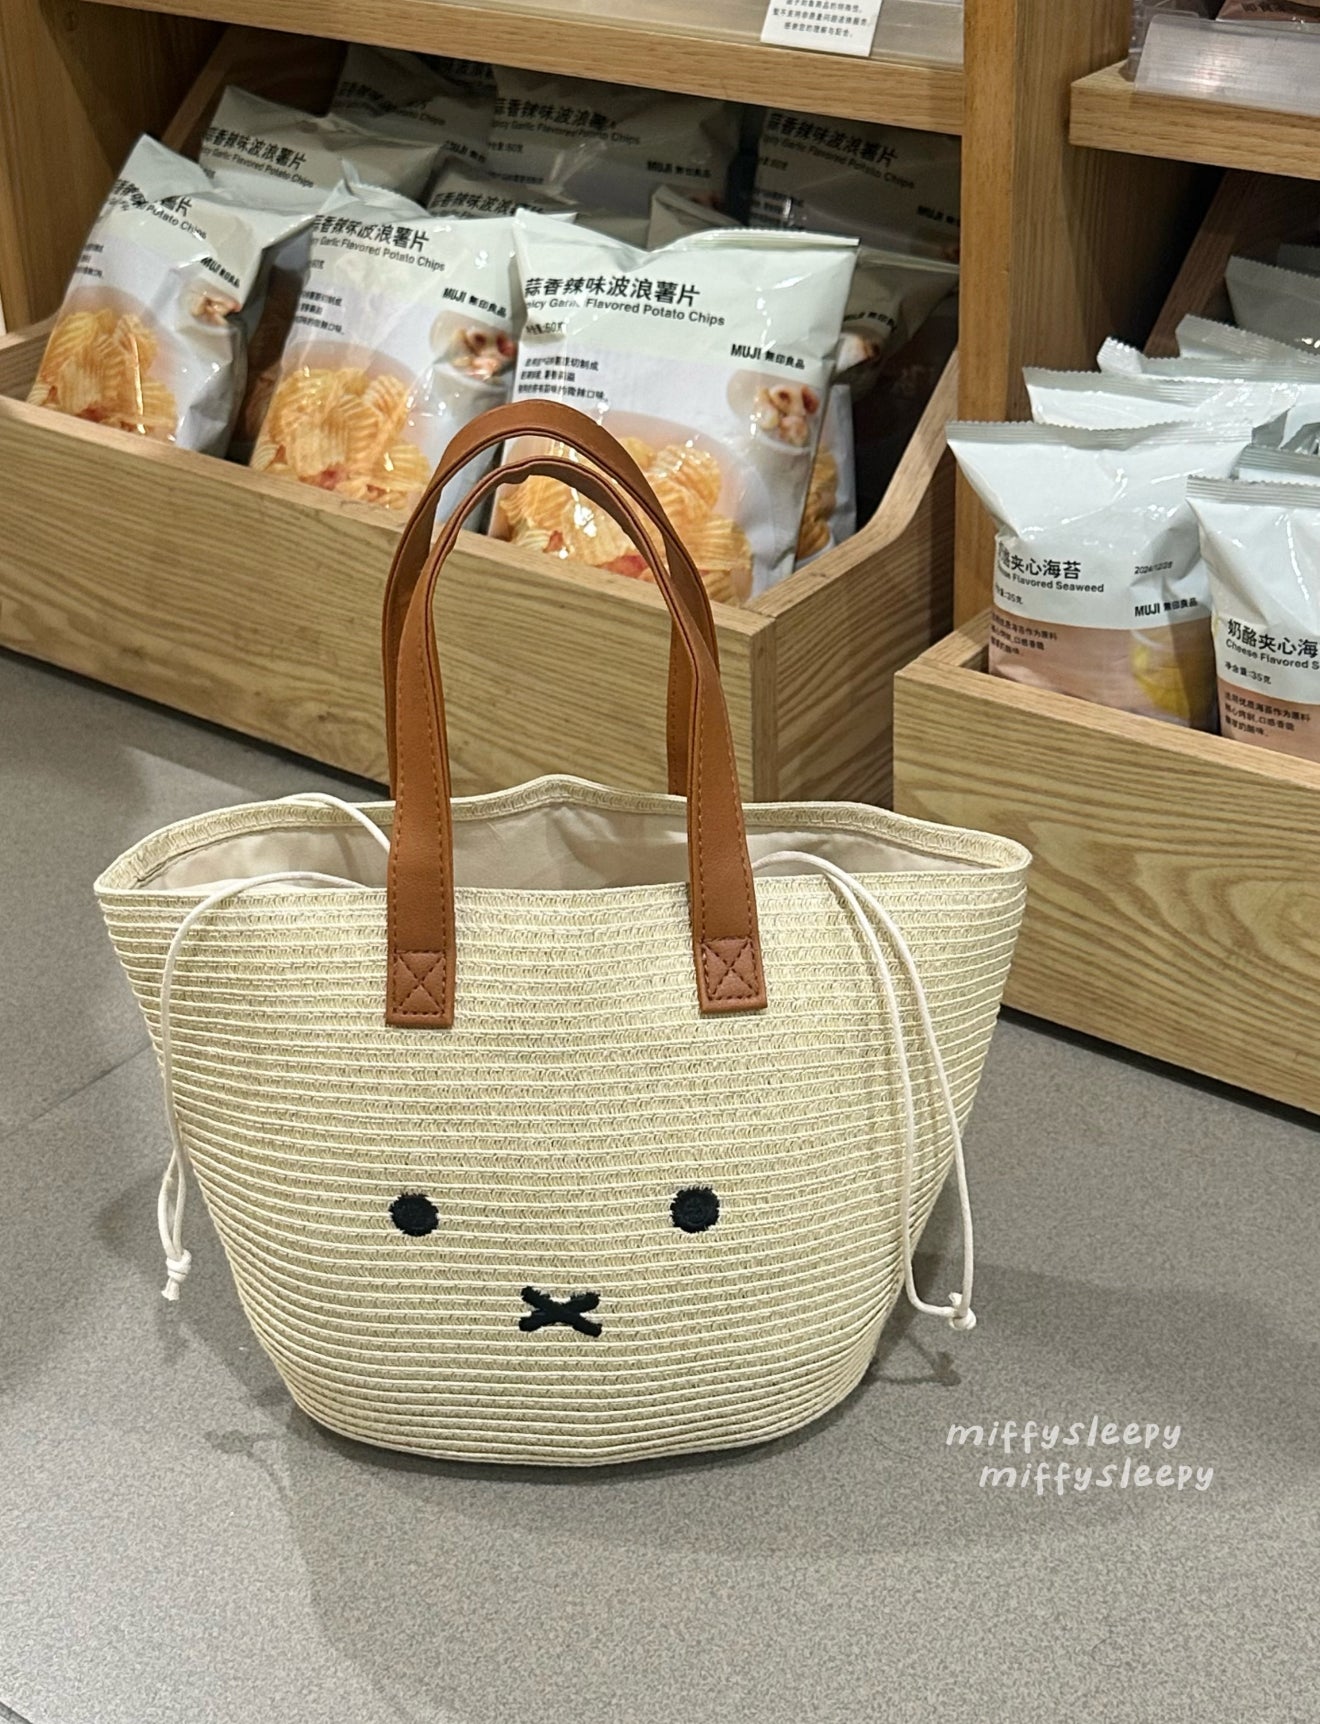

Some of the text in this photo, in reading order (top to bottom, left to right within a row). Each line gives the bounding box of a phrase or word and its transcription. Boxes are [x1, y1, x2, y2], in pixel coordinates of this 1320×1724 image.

[341, 239, 381, 256] Flavored
[383, 248, 415, 264] Potato
[417, 256, 446, 272] Chips
[442, 287, 468, 304] MUJI
[525, 275, 701, 307] 蒜香辣味波浪薯片
[586, 298, 640, 314] Flavored
[643, 304, 685, 320] Potato
[689, 311, 726, 327] Chips
[730, 343, 762, 361] MUJI
[1012, 572, 1053, 590] Flavored
[1055, 581, 1105, 593] Seaweed
[1134, 602, 1160, 618] MUJI
[1226, 638, 1259, 659] Cheese
[1260, 652, 1309, 670] Flavored
